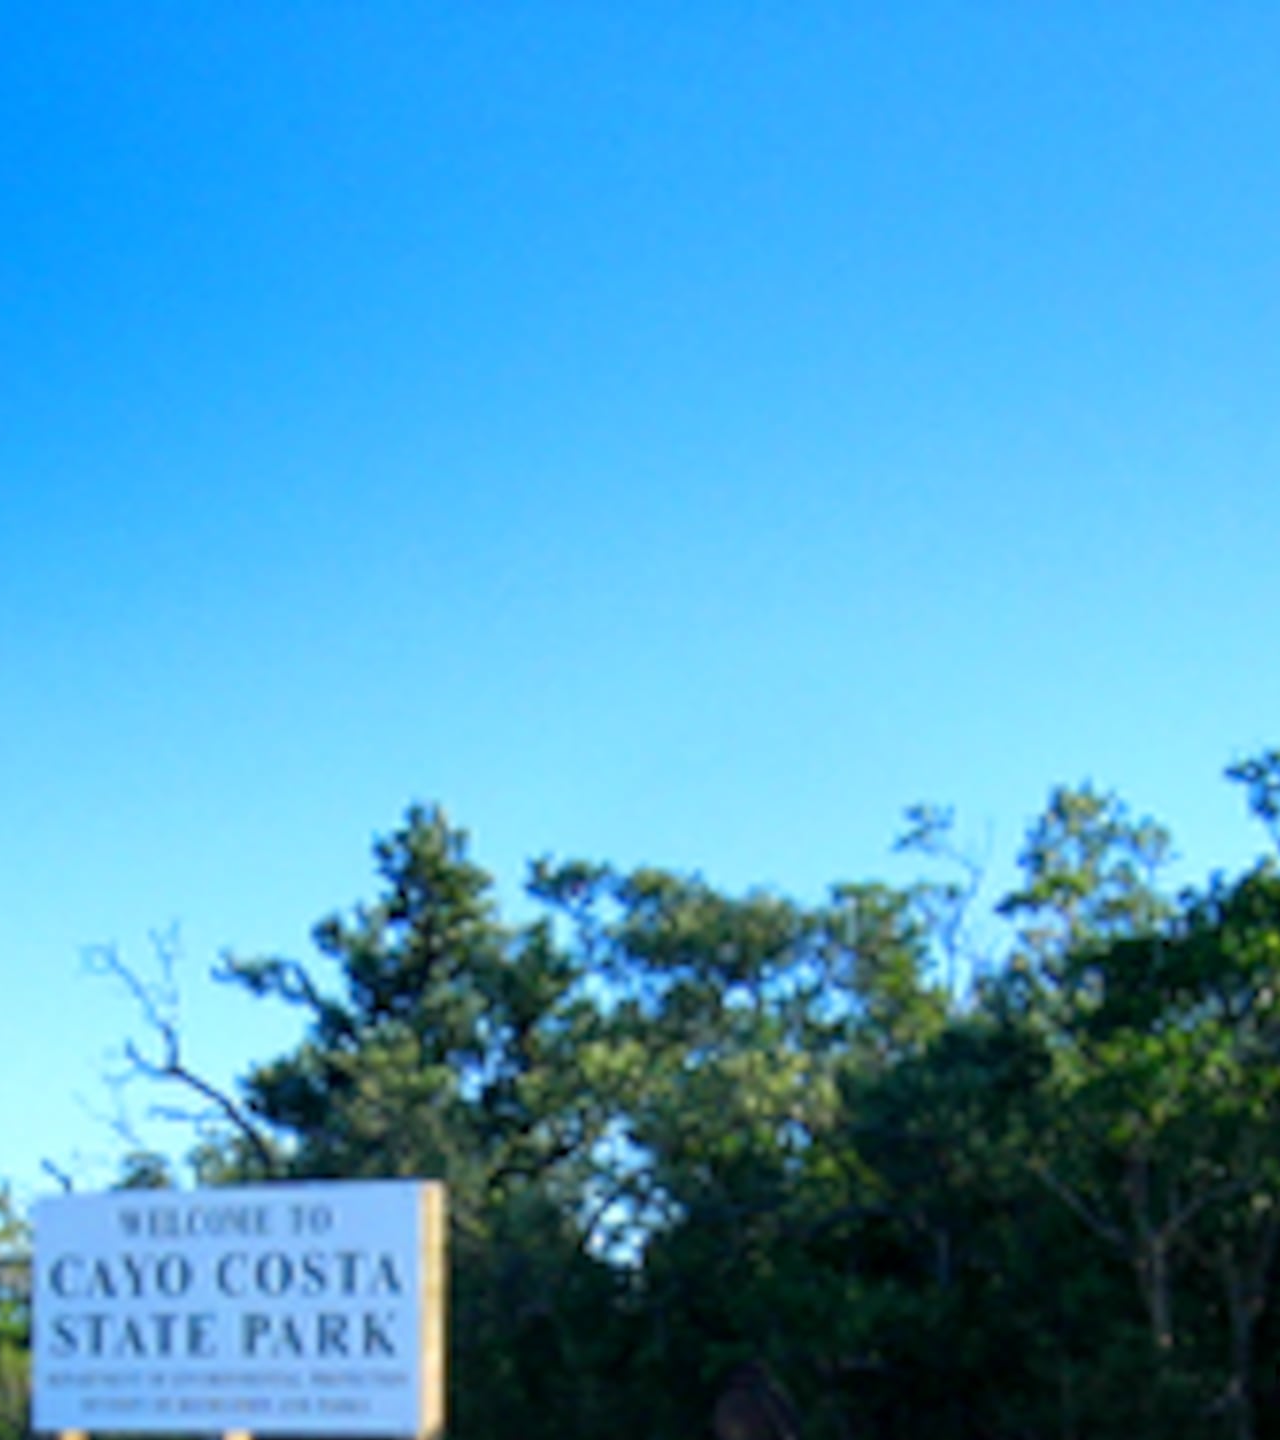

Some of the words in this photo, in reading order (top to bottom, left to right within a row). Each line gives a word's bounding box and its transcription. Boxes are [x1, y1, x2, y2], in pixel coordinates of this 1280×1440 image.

[120, 1206, 277, 1239] WELCOME
[291, 1205, 334, 1236] TO
[48, 1251, 193, 1300] CAYO
[216, 1250, 404, 1298] COSTA
[49, 1312, 218, 1359] STATE
[239, 1310, 399, 1359] PARK
